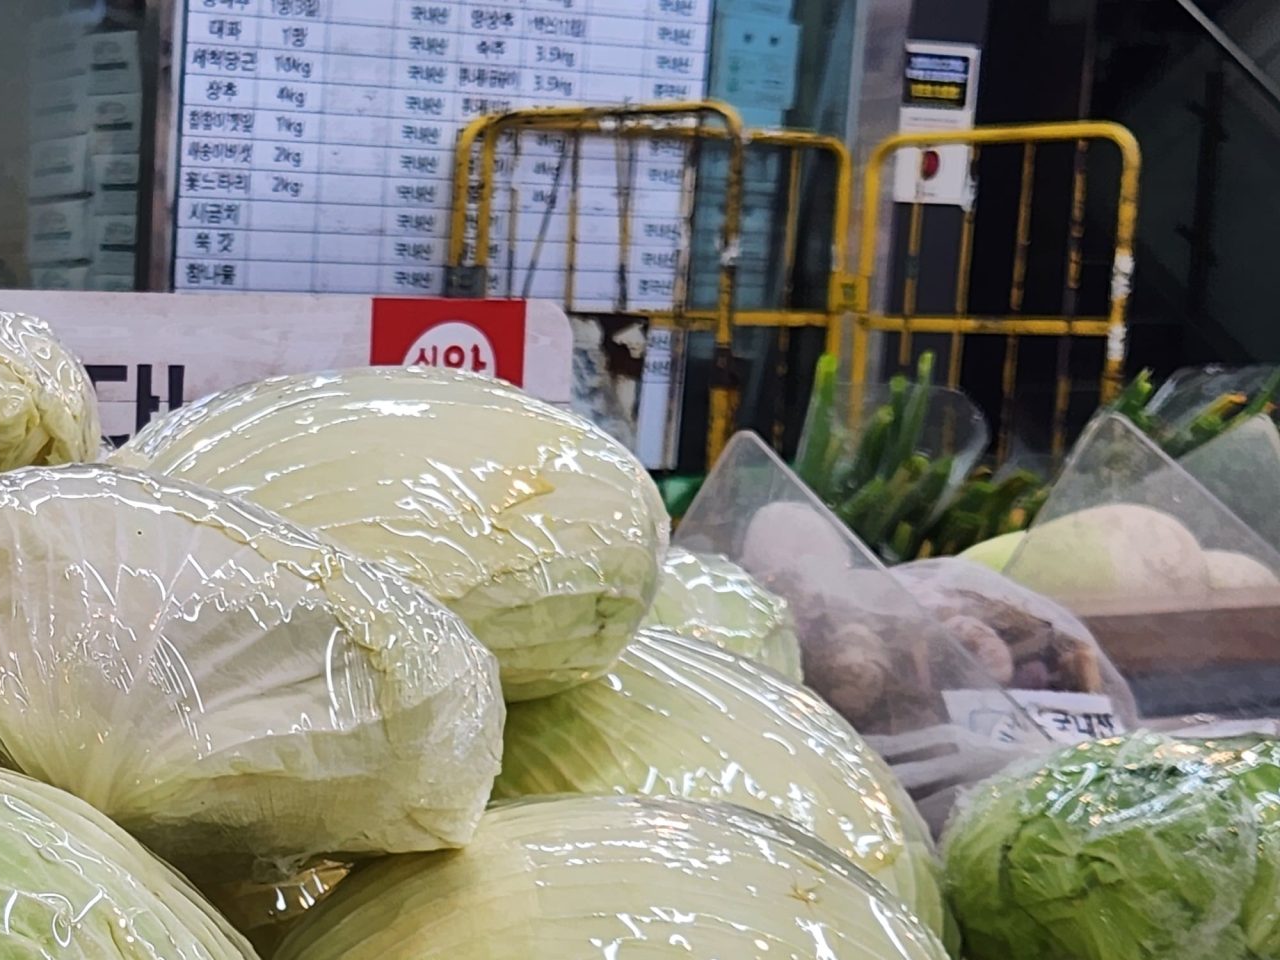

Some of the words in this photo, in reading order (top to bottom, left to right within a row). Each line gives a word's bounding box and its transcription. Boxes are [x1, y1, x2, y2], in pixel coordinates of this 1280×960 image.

[209, 20, 241, 40] 대파
[192, 48, 257, 72] 세척당근
[206, 80, 238, 102] 상추
[187, 142, 253, 163] 새송이버섯
[274, 146, 302, 167] 2kg
[272, 176, 301, 198] 2kg
[189, 203, 240, 225] 시금치
[186, 262, 236, 285] 참나물
